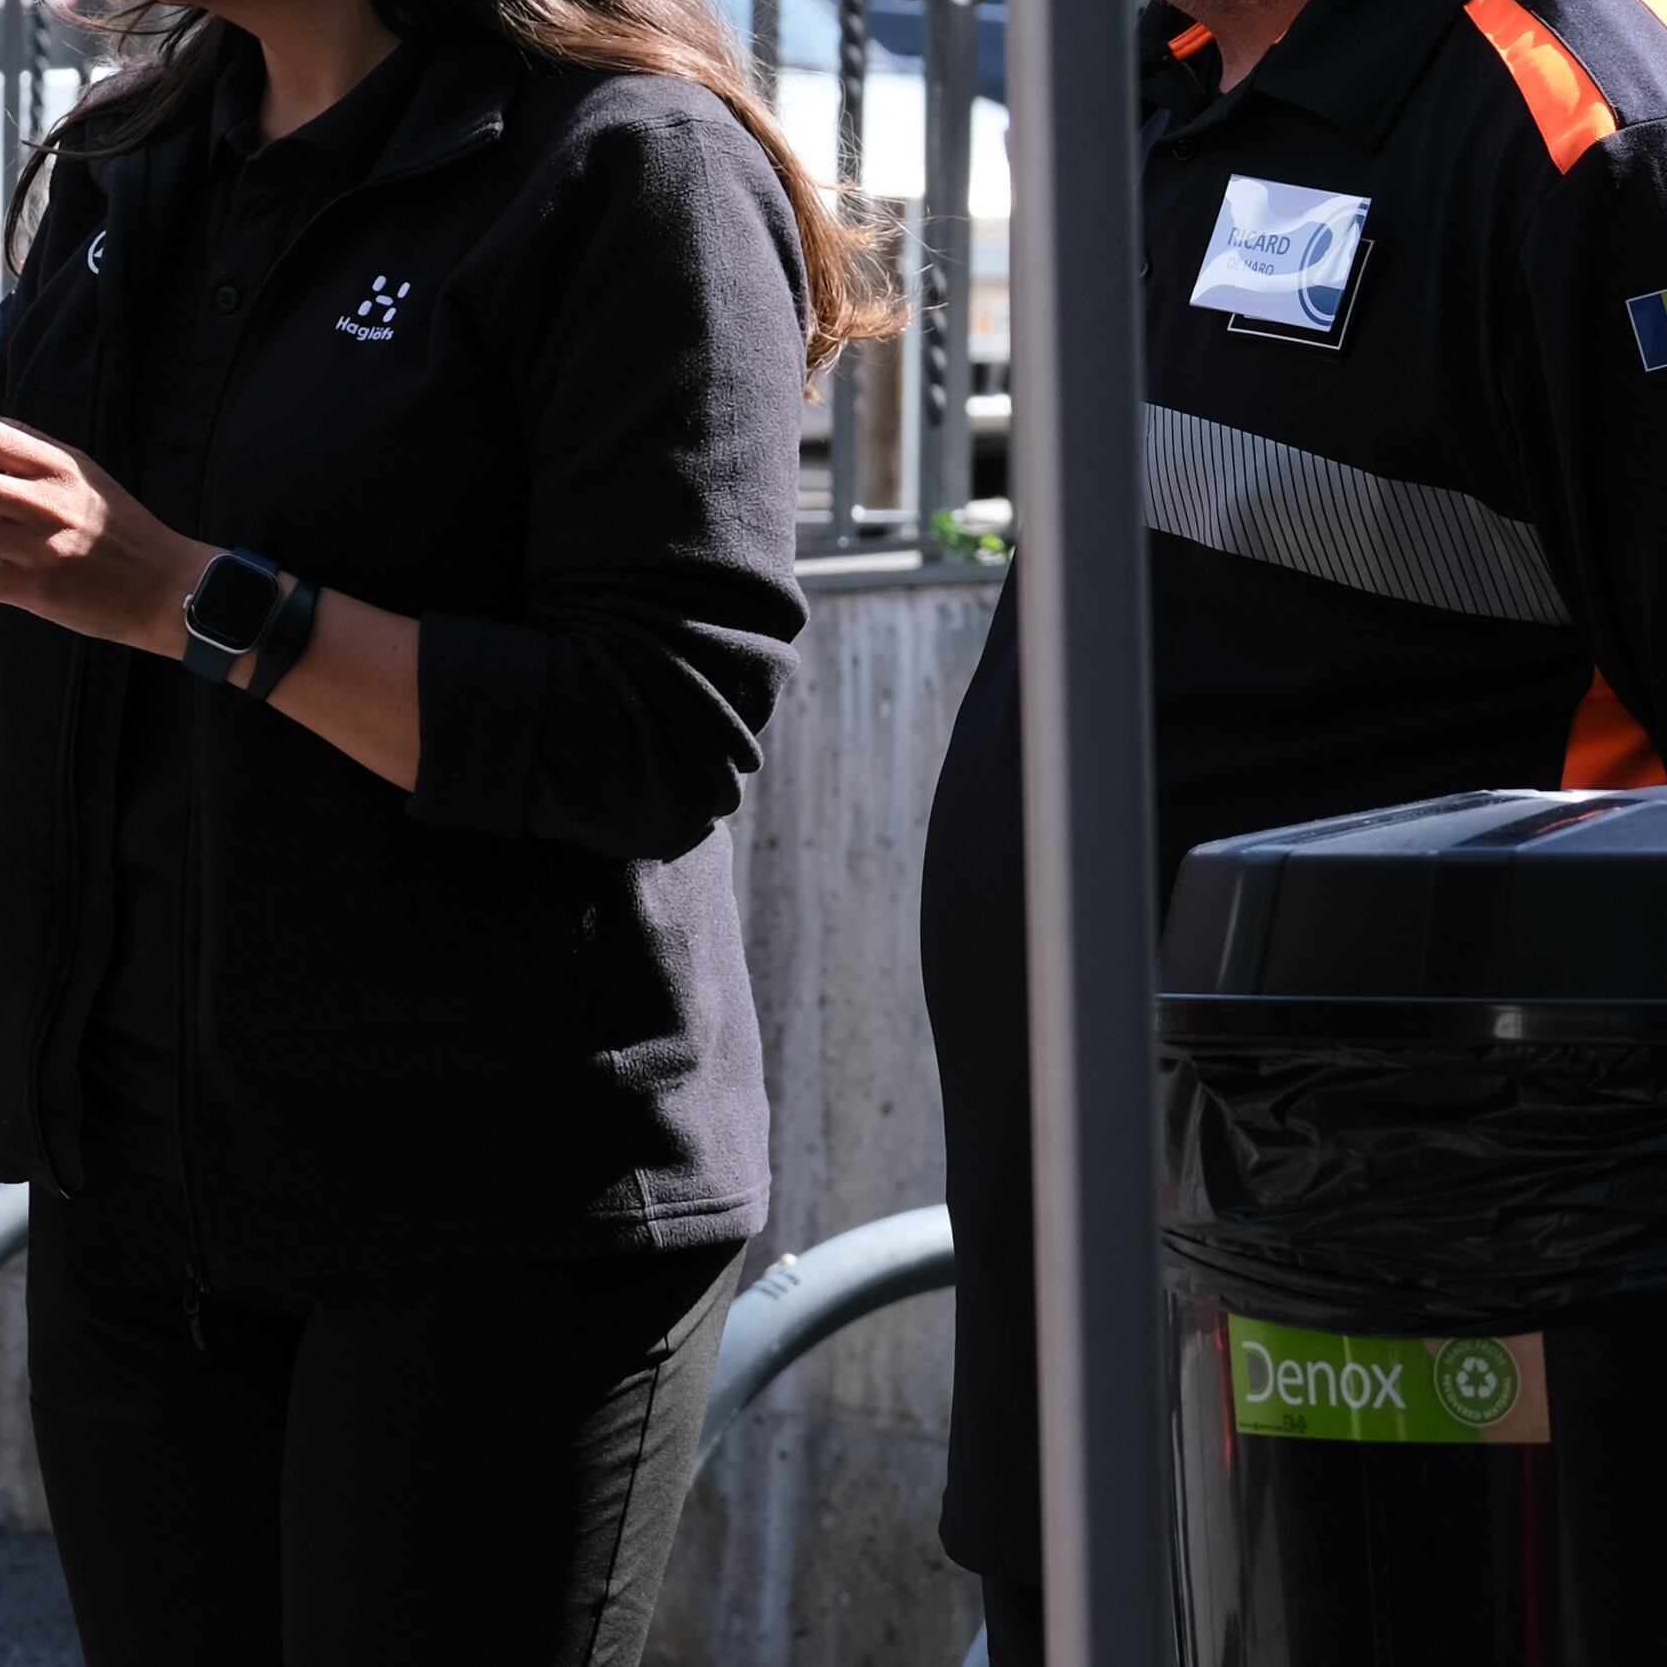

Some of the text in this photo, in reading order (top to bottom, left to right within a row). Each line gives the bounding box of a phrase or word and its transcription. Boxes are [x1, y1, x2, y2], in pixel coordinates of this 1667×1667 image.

[1227, 226, 1291, 255] RICARD
[335, 315, 394, 341] Haglöfs
[1241, 1340, 1406, 1410] Denox
